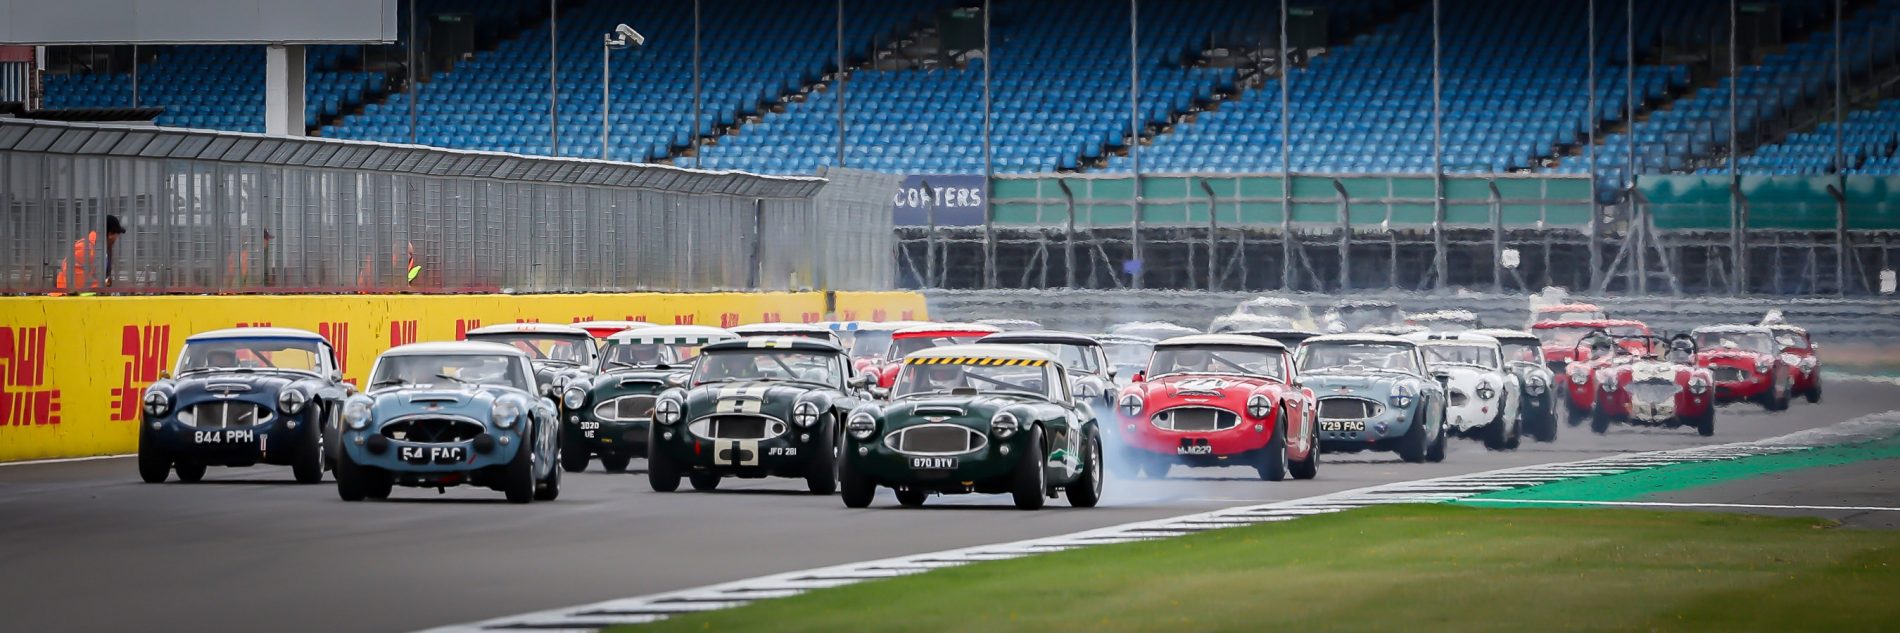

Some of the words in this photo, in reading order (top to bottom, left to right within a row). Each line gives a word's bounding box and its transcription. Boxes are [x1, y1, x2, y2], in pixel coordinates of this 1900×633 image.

[1321, 421, 1341, 431] 729
[1343, 421, 1364, 431] FAC
[195, 431, 221, 443] 844
[226, 429, 254, 443] PPH
[403, 447, 423, 461] 54
[431, 447, 461, 461] FAC
